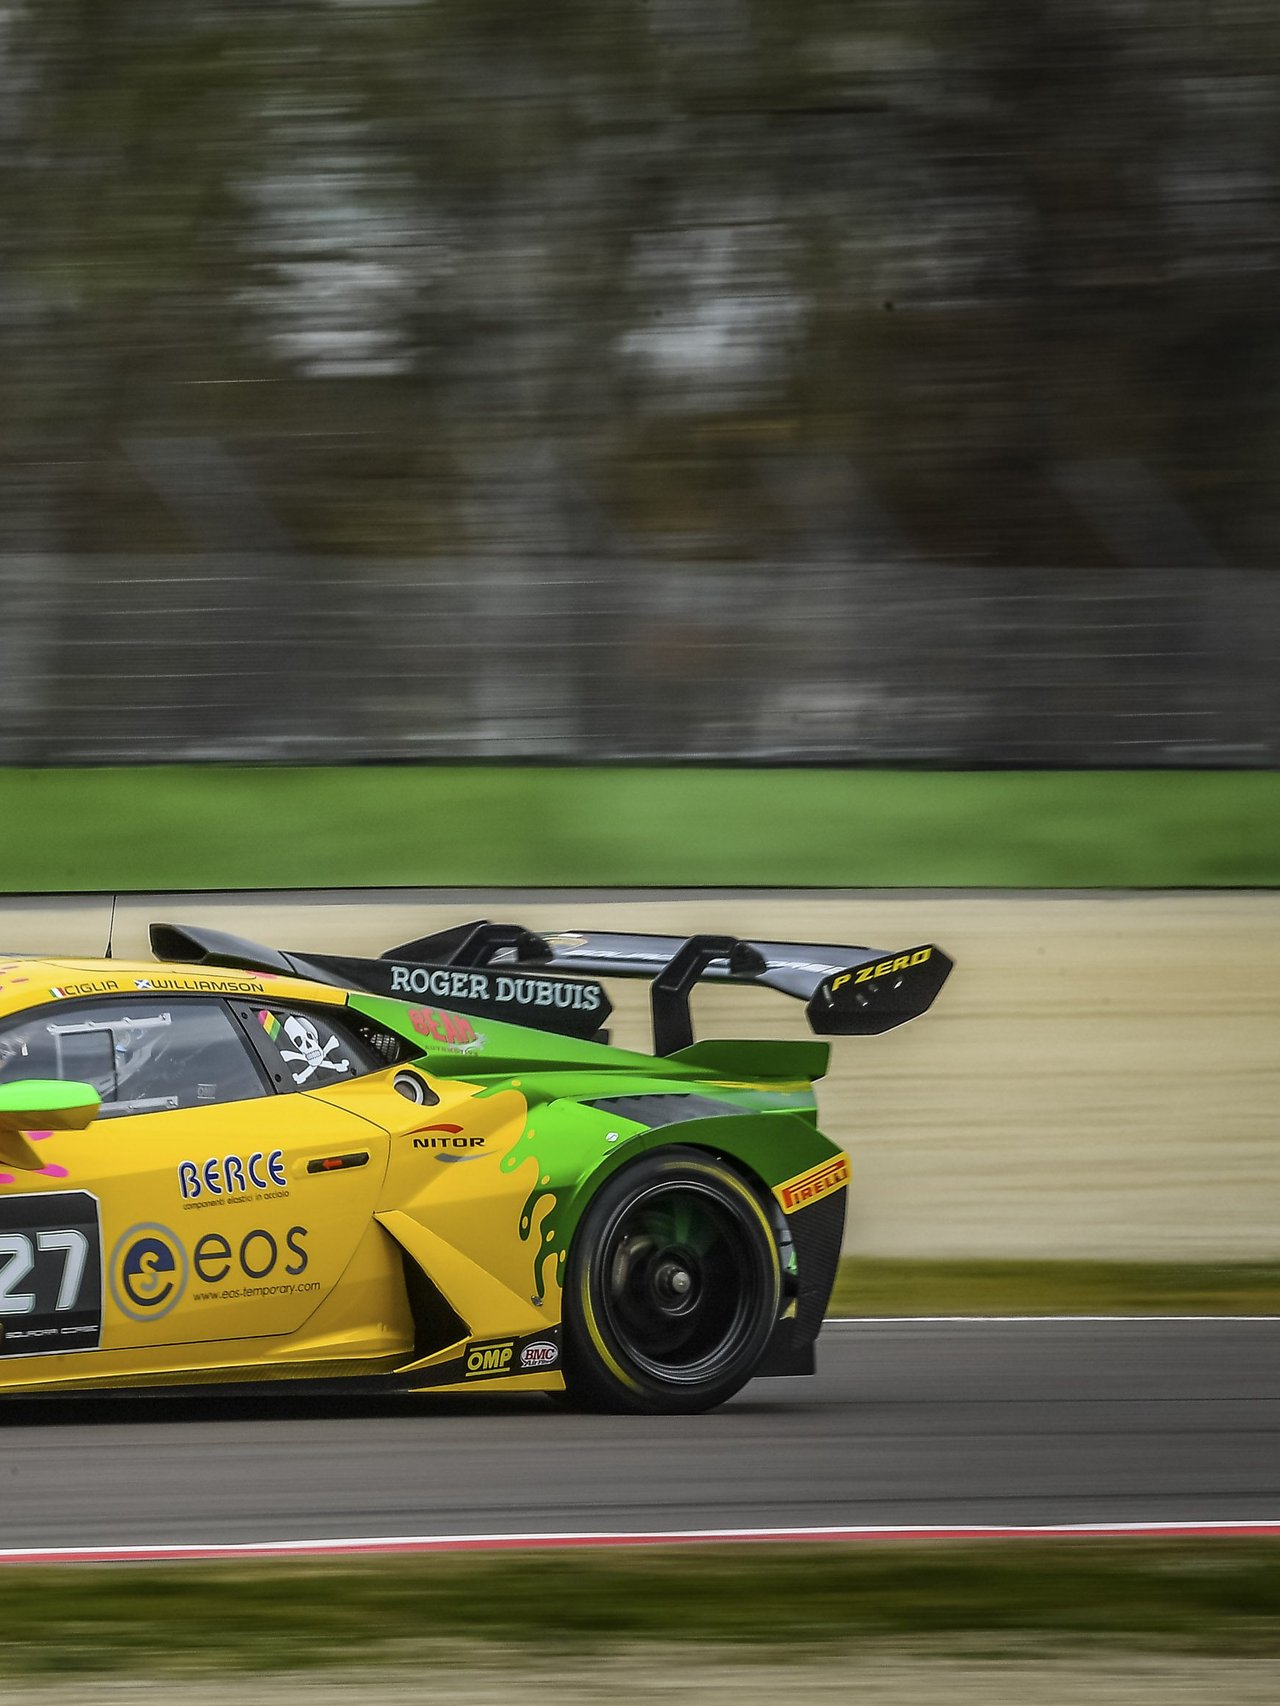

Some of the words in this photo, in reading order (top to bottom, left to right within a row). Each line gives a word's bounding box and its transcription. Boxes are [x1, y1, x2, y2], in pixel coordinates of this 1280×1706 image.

[831, 974, 853, 992] P
[854, 947, 932, 985] ZERO
[64, 980, 119, 996] CIGLIA
[150, 979, 264, 993] WILLIAMSON
[390, 966, 490, 1000] ROGER
[495, 977, 601, 1011] DUBUIS
[413, 1137, 485, 1148] NITOR
[177, 1148, 287, 1199] BERCE
[782, 1159, 848, 1209] PIRELLI
[193, 1225, 308, 1283] eos
[192, 1281, 321, 1302] www.eos-temporary.com
[467, 1347, 513, 1371] OMP
[524, 1348, 555, 1360] BMC
